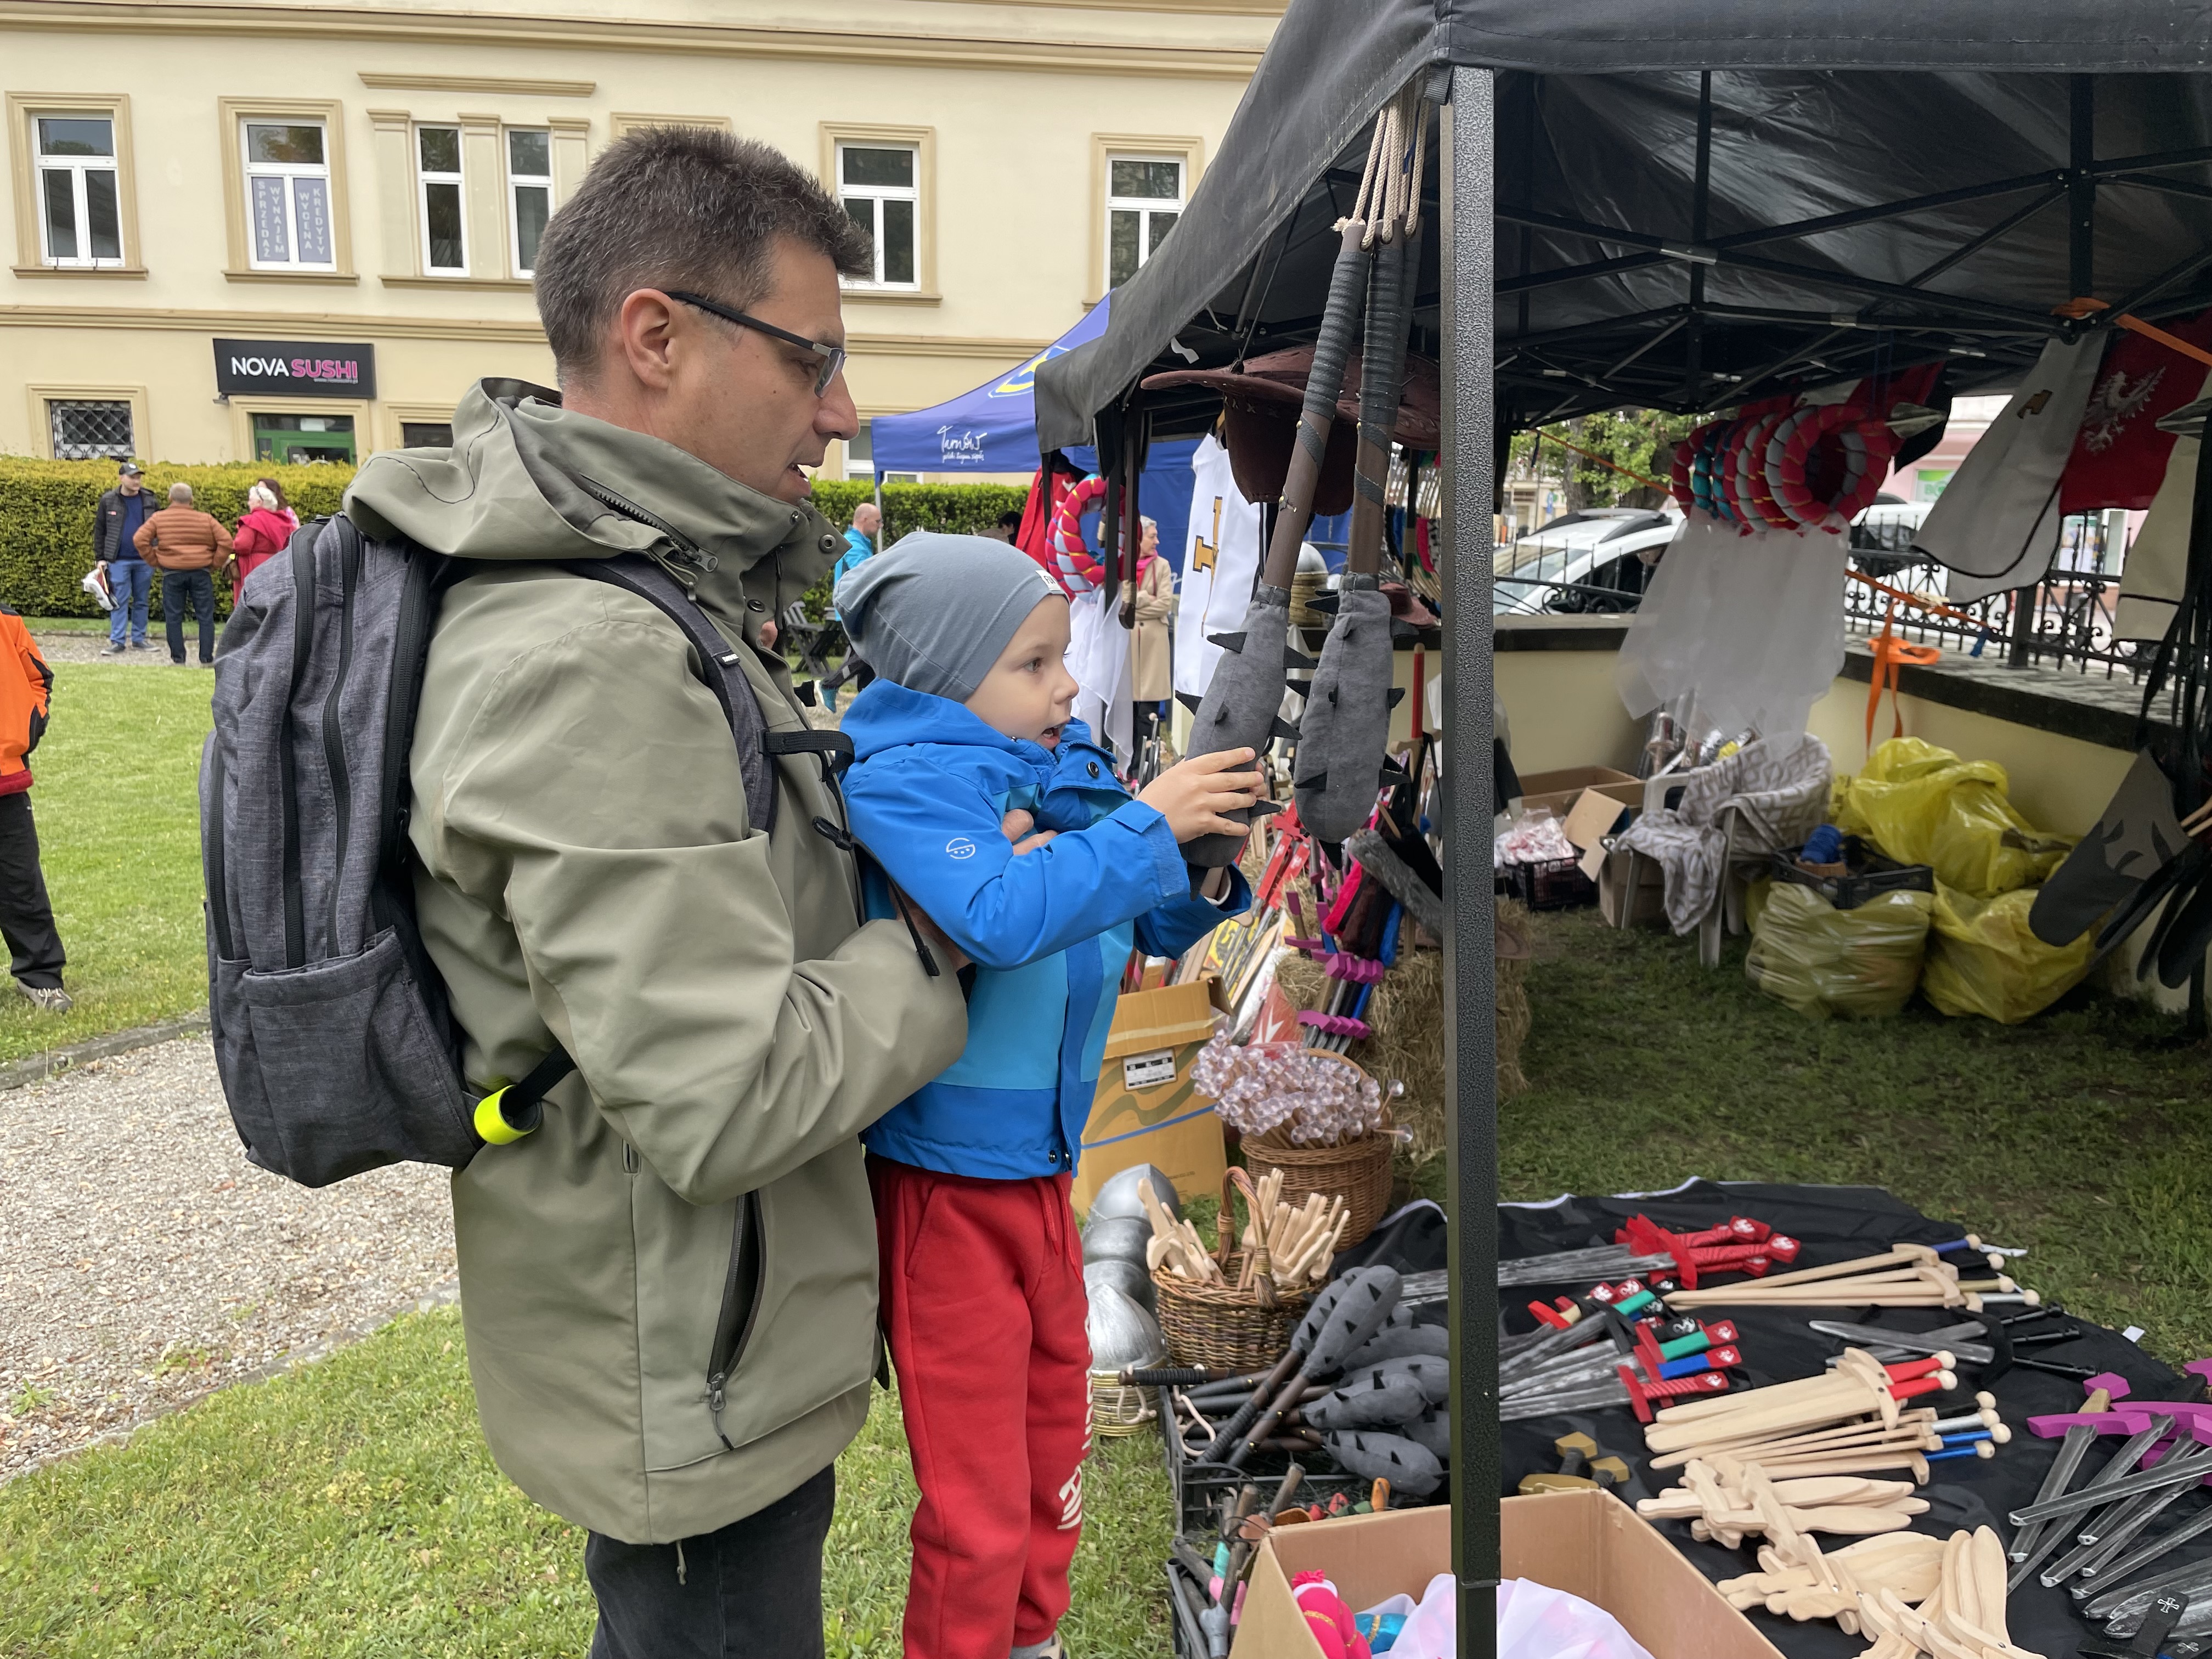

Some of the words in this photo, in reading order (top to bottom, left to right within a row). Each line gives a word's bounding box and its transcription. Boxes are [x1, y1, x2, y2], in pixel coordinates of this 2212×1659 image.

[269, 187, 285, 254] WYNAJEM
[299, 193, 313, 250] WYCENA
[313, 188, 325, 255] KREDYTY
[231, 357, 290, 377] NOVA
[291, 358, 359, 379] SUSHI
[936, 425, 988, 453] Tarnów
